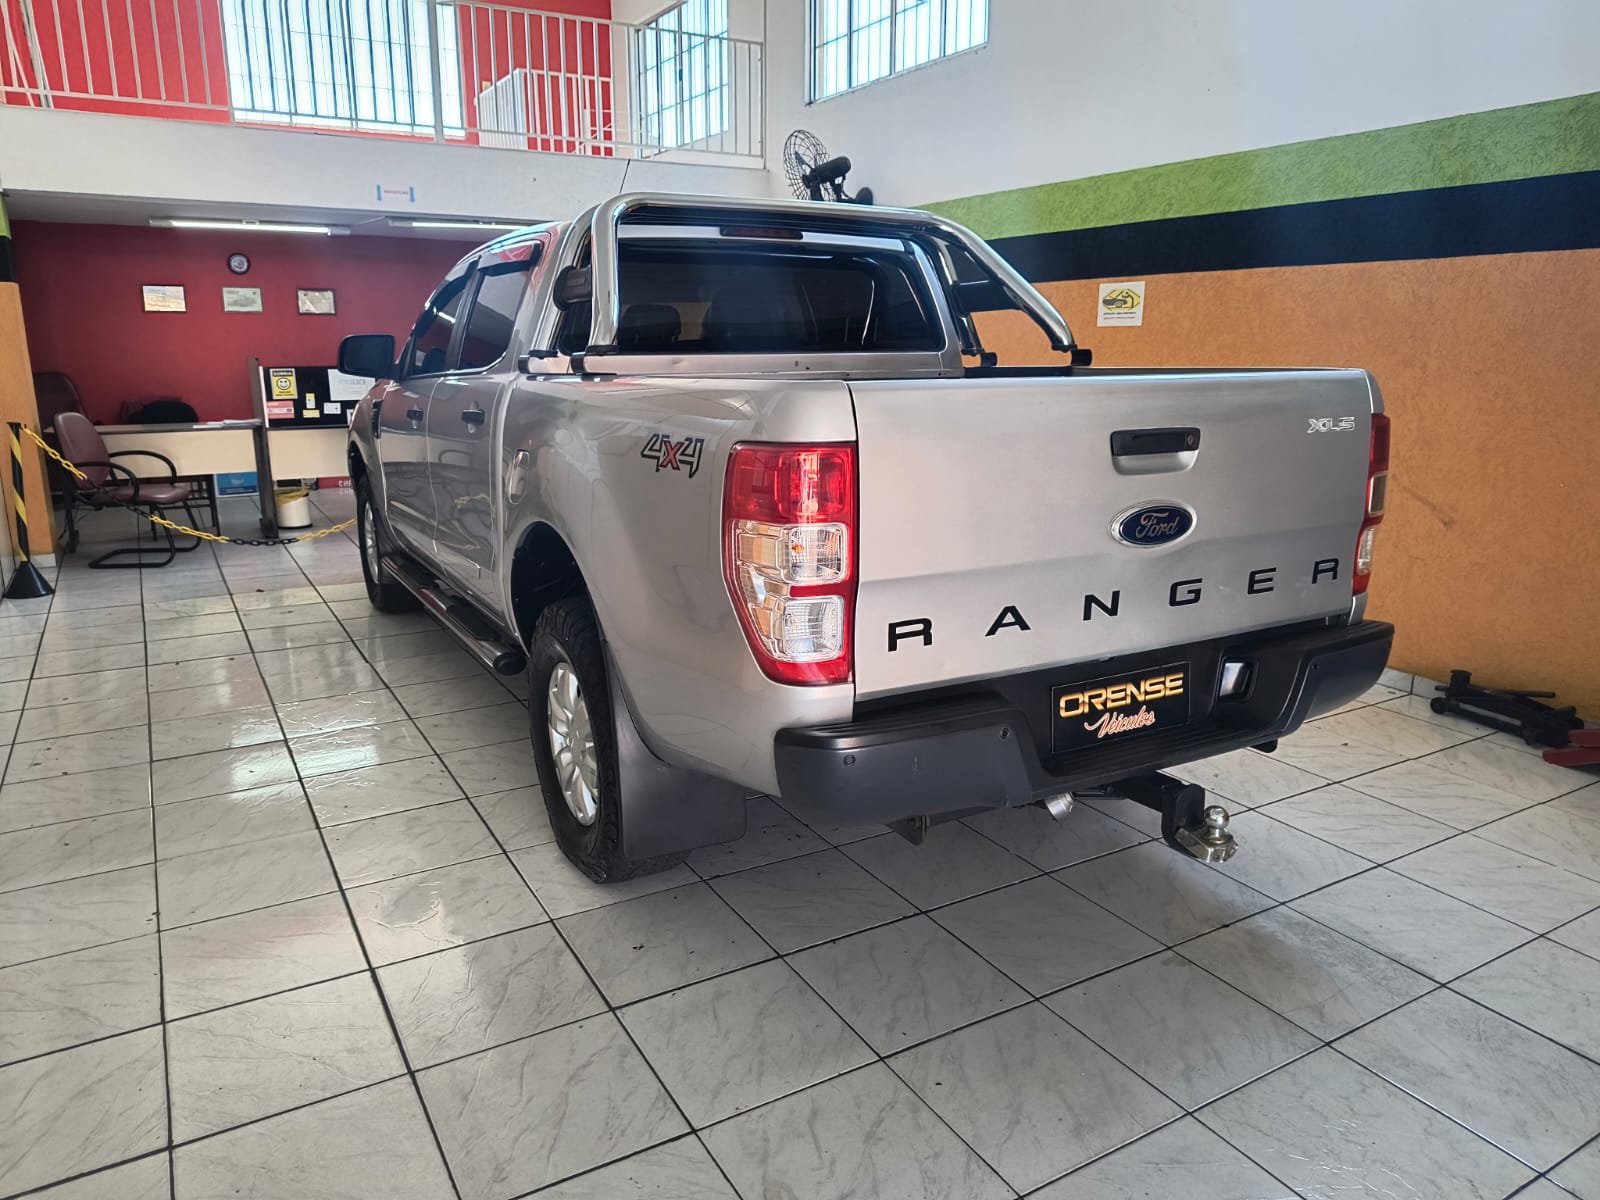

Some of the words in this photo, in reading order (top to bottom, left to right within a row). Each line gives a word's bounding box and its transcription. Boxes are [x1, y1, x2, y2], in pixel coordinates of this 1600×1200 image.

[1307, 416, 1355, 433] XLS
[1135, 512, 1179, 538] Ford
[887, 558, 1339, 652] RANGER
[1059, 672, 1184, 718] ORENSE
